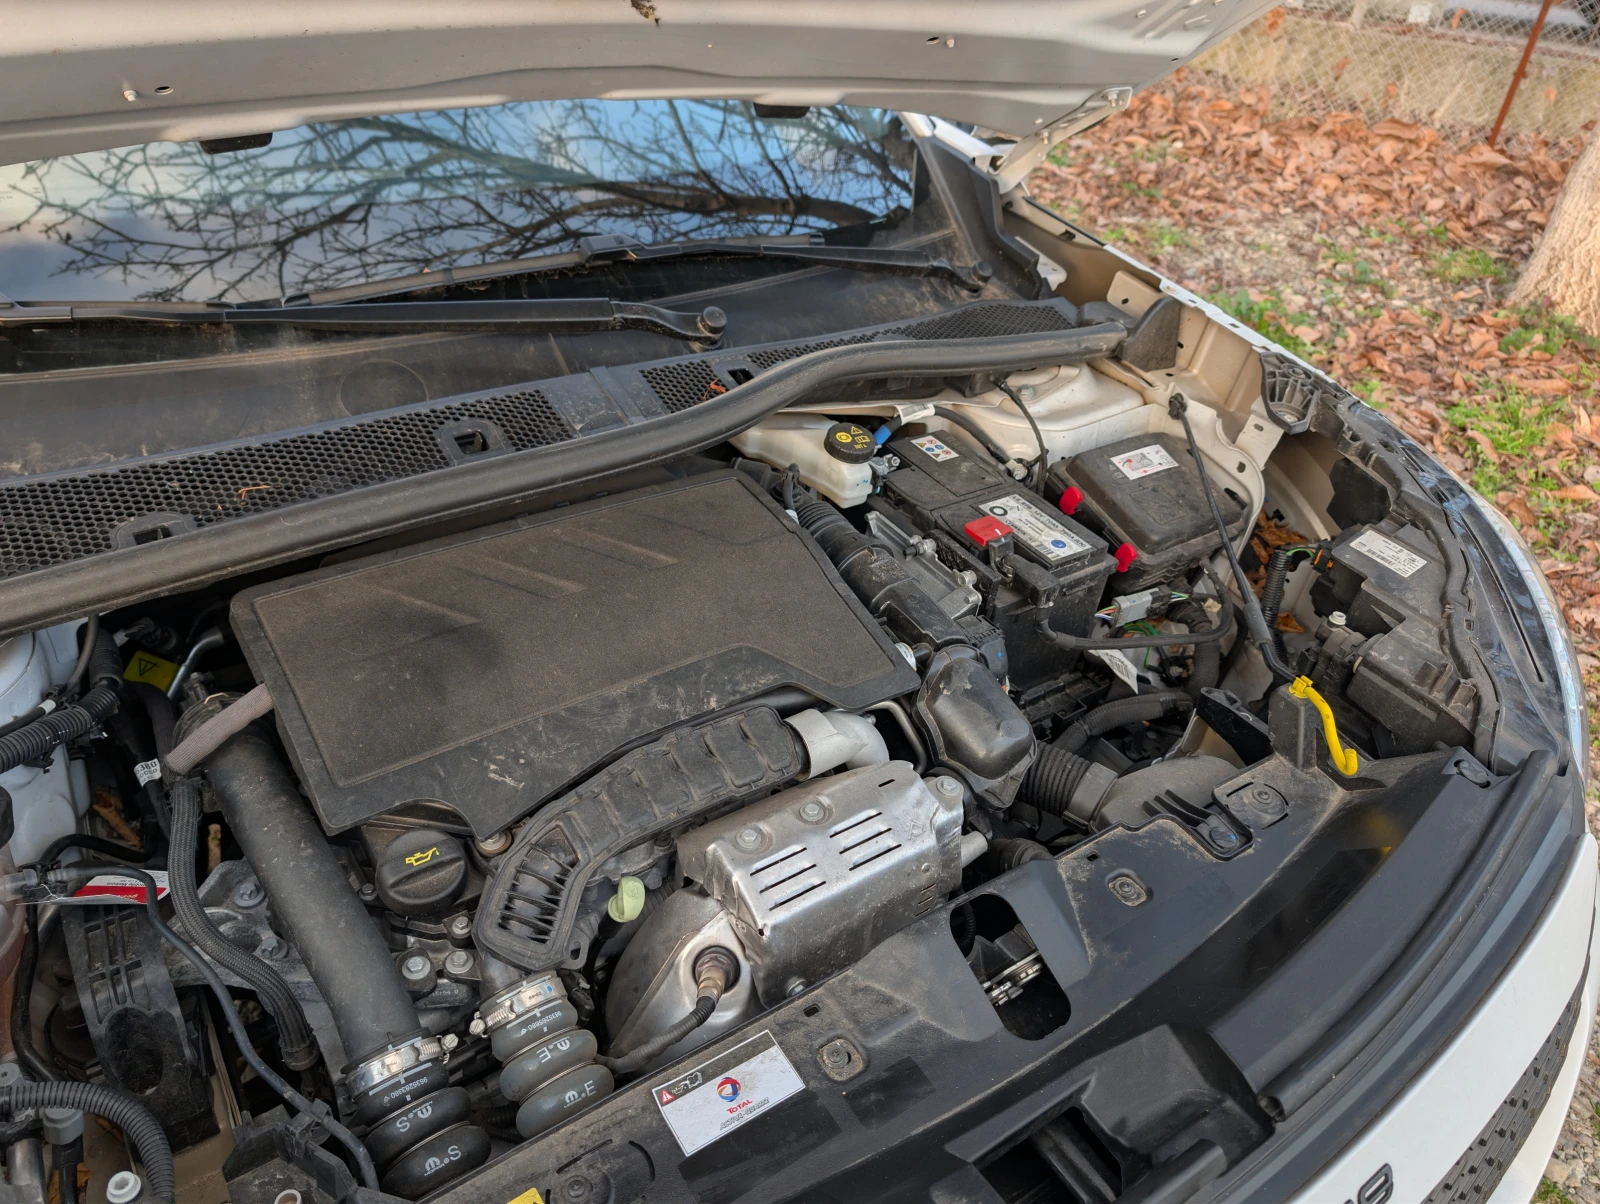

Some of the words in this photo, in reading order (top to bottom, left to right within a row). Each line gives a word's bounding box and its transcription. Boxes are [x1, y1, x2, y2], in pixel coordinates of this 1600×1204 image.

[584, 1080, 597, 1096] E
[726, 1099, 753, 1114] TOTAL
[448, 1145, 462, 1161] S
